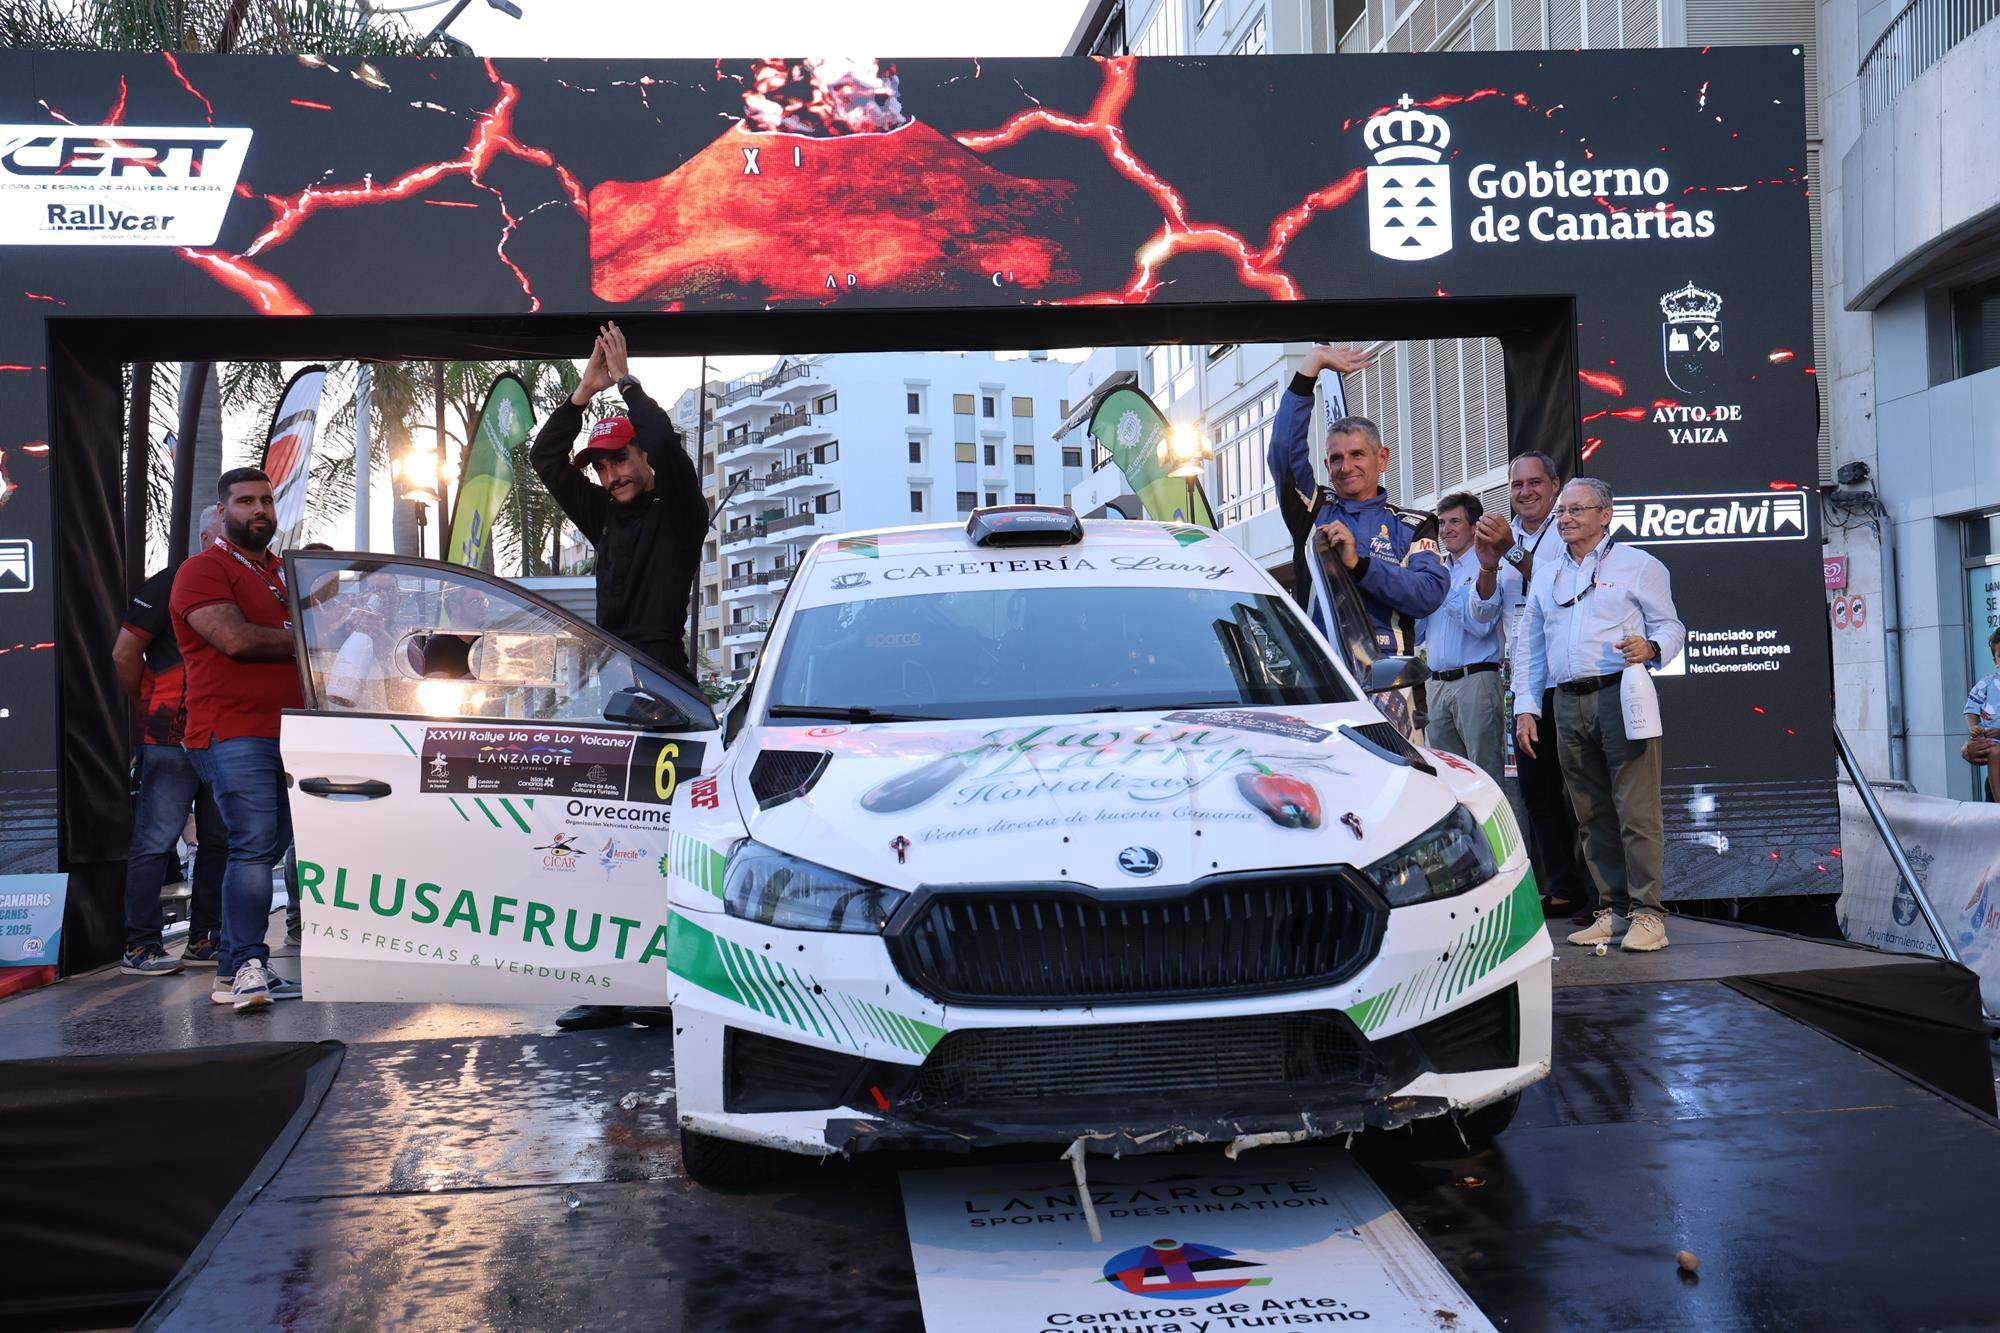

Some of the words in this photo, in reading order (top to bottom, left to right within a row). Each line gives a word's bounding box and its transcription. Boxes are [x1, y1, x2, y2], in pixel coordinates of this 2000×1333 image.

[1, 137, 227, 177] CERT
[1468, 160, 1669, 199] Gobierno
[47, 204, 175, 230] Rallycar
[1470, 206, 1520, 243] de
[1528, 202, 1715, 242] Canarias
[1653, 406, 1710, 423] AYTO.
[1715, 405, 1742, 421] DE
[1668, 427, 1728, 444] YAIZA
[1639, 500, 1770, 537] Recalvi
[883, 555, 1097, 581] CAFETERÍA
[1110, 555, 1234, 580] Larry
[1688, 629, 1753, 642] Financiado
[1756, 629, 1777, 643] por
[1689, 646, 1700, 657] la
[1702, 644, 1738, 657] Unión
[1741, 644, 1791, 656] Europea
[1689, 660, 1780, 674] NextGenerationEU
[427, 730, 467, 741] XXVII
[469, 730, 504, 743] Rallye
[509, 732, 528, 742] Isla
[533, 732, 549, 742] de
[555, 733, 573, 743] Los
[580, 734, 631, 748] Volcanes
[478, 753, 571, 766] LANZAROTE
[655, 743, 679, 800] 6
[953, 771, 1198, 805] Hortalizas
[567, 799, 671, 824] Orvecame
[920, 826, 977, 842] Venta
[987, 816, 1056, 833] directa
[1065, 810, 1088, 823] de
[1096, 808, 1160, 821] huerta
[1172, 805, 1253, 820] Canaria
[543, 855, 576, 868] CICAR
[614, 849, 638, 860] Arrecife
[0, 893, 51, 906] CANARIAS
[298, 860, 667, 963] RLUSAFRUTA
[6, 925, 32, 935] 2025
[1867, 926, 1925, 951] Ayuntamiento
[1926, 939, 1937, 953] de
[361, 932, 458, 962] FRESCAS
[470, 953, 481, 968] &
[495, 958, 612, 989] VERDURAS
[964, 1180, 1317, 1213] LANZAROTE
[1110, 1197, 1329, 1219] DESTINATION
[1047, 1305, 1197, 1326] Centros
[1206, 1302, 1250, 1315] de
[1262, 1296, 1348, 1312] Arte,
[1217, 1308, 1372, 1329] Turismo
